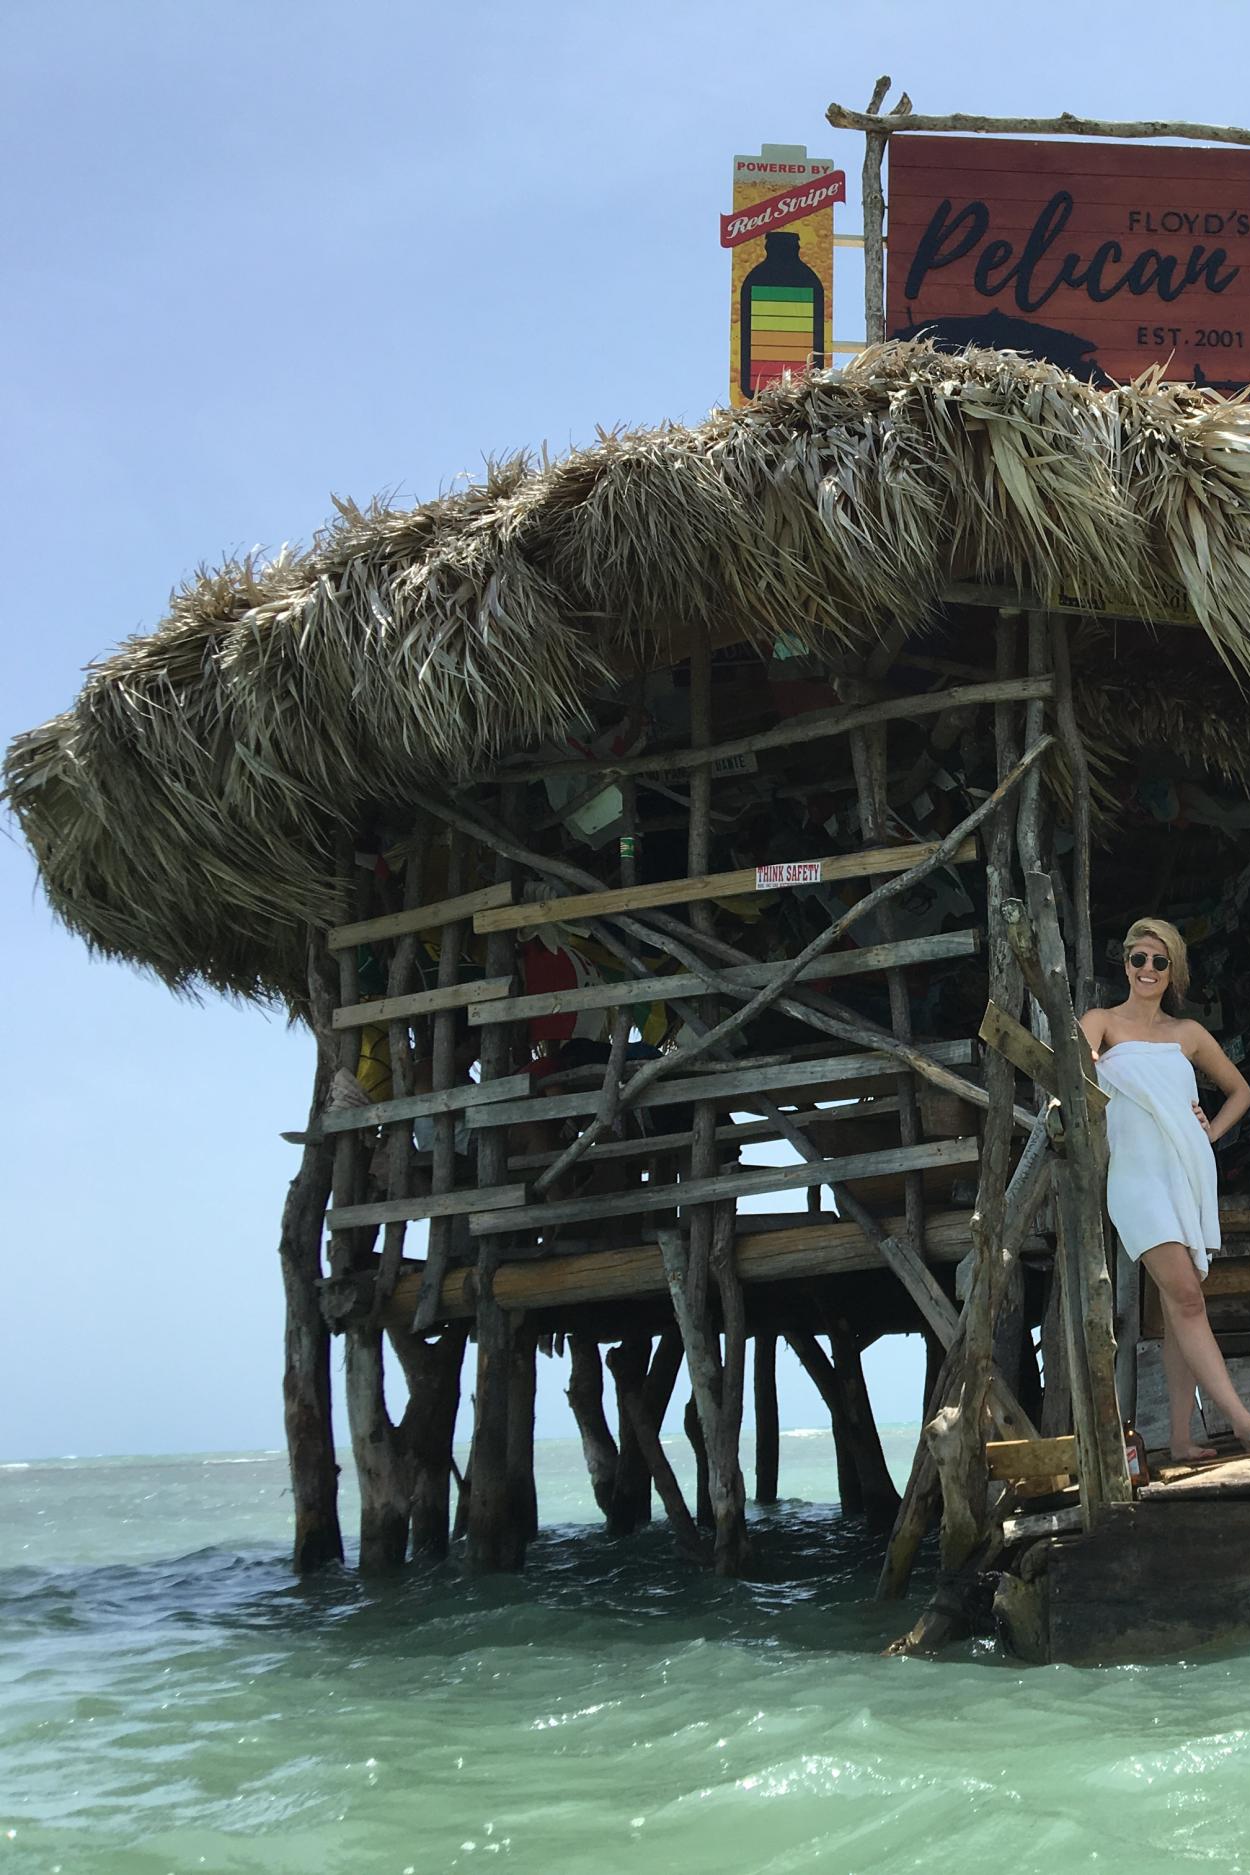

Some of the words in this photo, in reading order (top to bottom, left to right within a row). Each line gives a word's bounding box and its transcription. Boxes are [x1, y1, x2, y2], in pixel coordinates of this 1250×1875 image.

[736, 161, 806, 174] POWERED
[811, 165, 830, 174] BY
[725, 205, 773, 239] Red
[774, 182, 840, 218] Stripe
[1128, 210, 1250, 235] FLOYD'S
[904, 190, 1240, 313] Pelican
[757, 864, 785, 883] THINK
[786, 863, 819, 882] SAFETY
